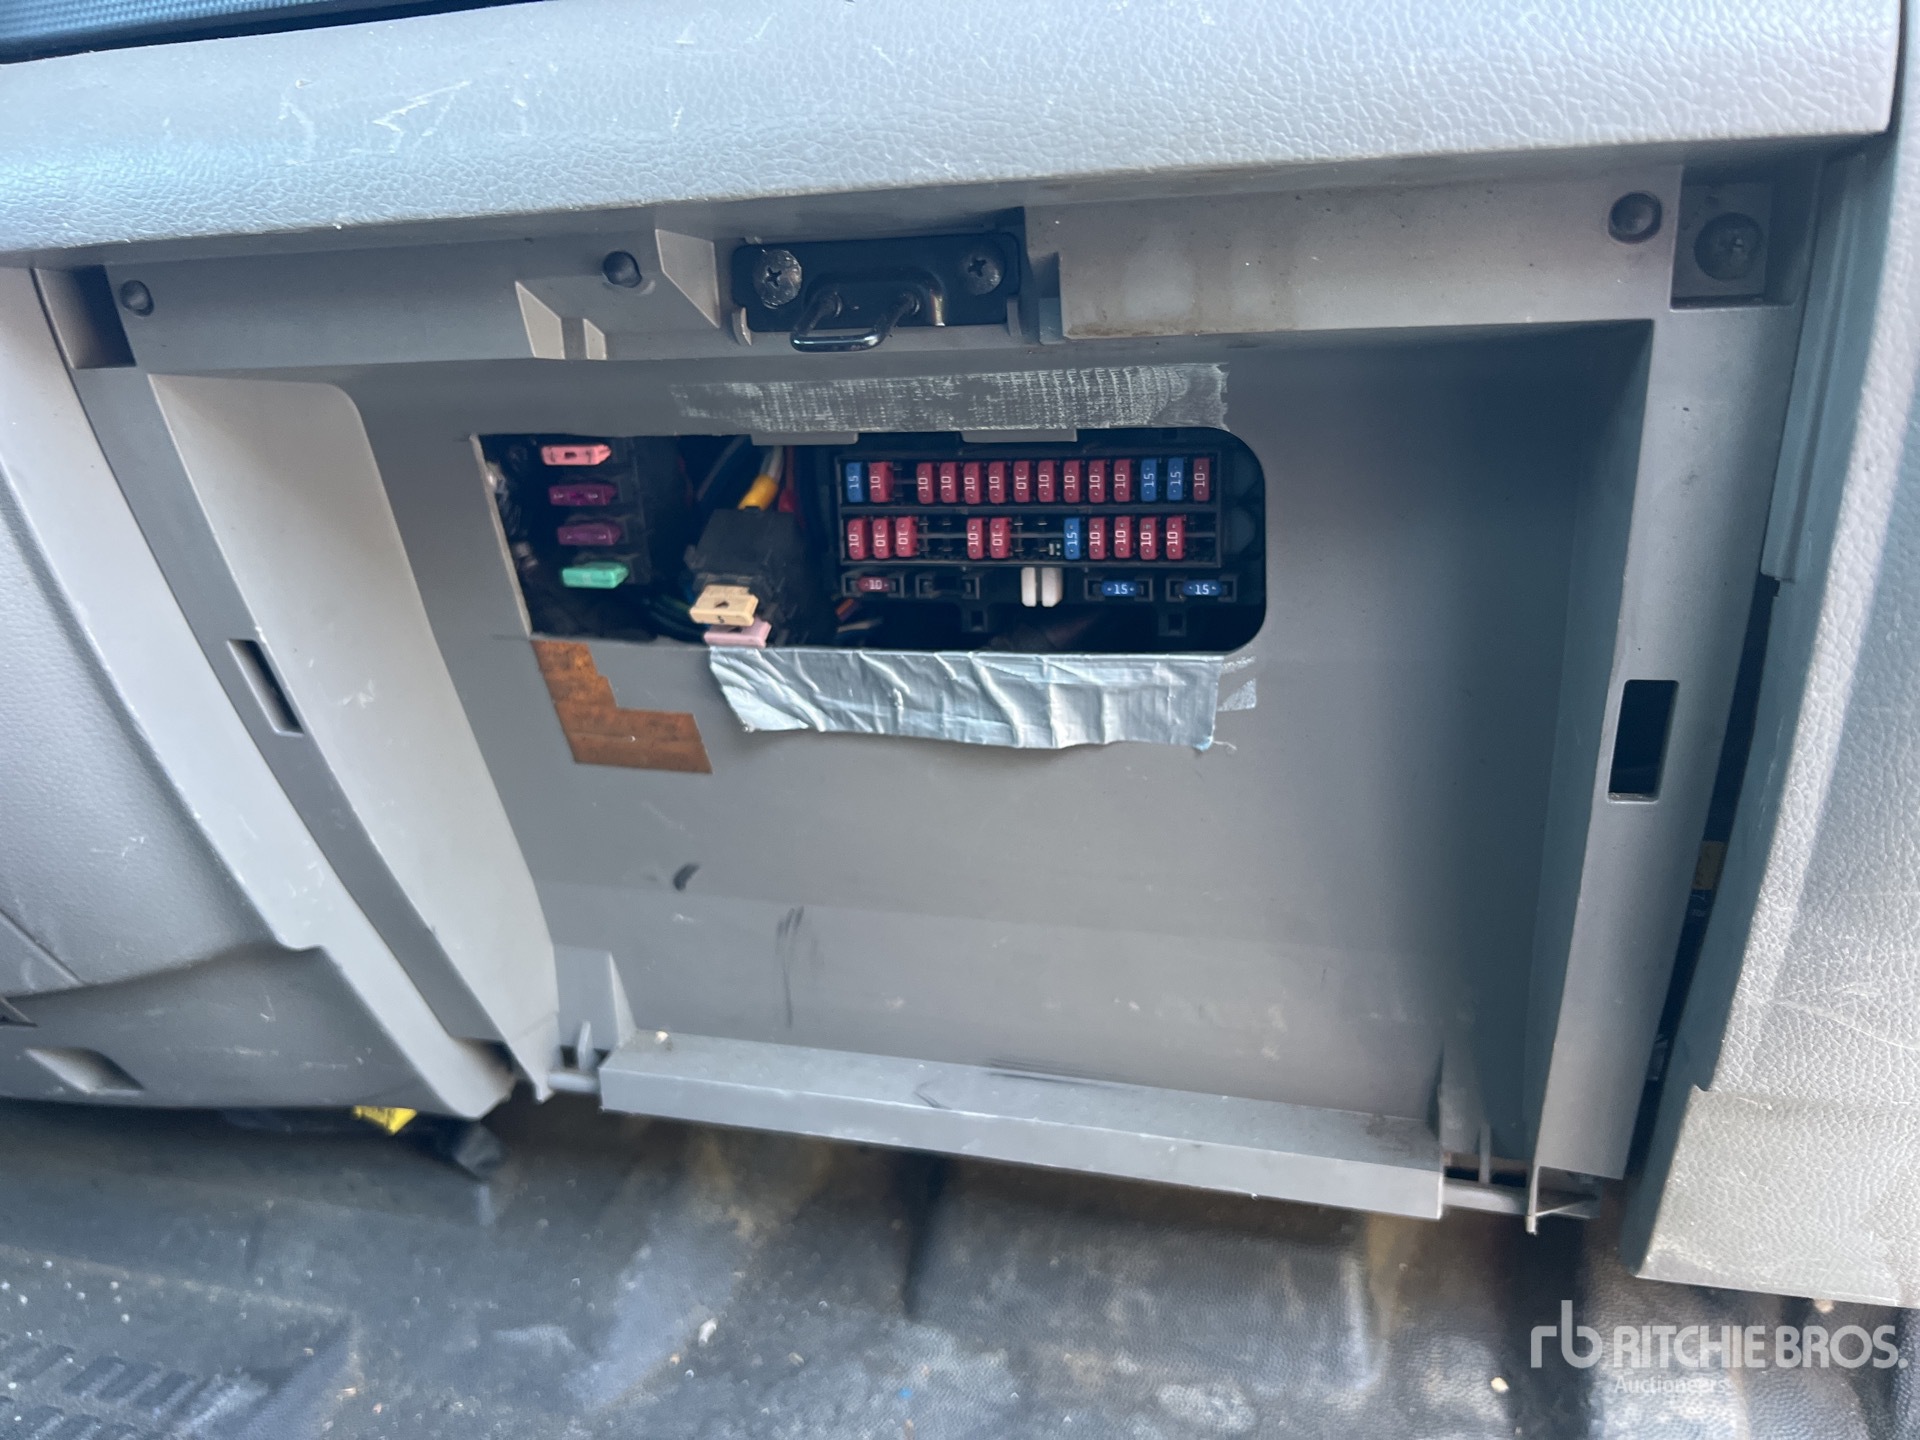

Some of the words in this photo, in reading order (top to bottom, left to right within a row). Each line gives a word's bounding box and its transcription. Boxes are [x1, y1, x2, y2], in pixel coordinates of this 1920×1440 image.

[850, 476, 859, 488] 15
[871, 476, 880, 489] 10
[918, 478, 928, 491] 10
[941, 476, 951, 489] 10
[965, 477, 975, 491] 10
[989, 477, 999, 490] 10
[1016, 476, 1027, 489] 10
[1039, 475, 1049, 488] 10
[1065, 476, 1075, 489] 10
[1089, 475, 1100, 489] 10
[1115, 474, 1125, 488] 10
[1144, 473, 1154, 488] 15
[1171, 472, 1181, 486] 15
[1195, 473, 1205, 487] 10
[849, 534, 859, 547] 10
[876, 534, 885, 547] 10
[898, 532, 908, 544] 10
[968, 533, 978, 546] 10
[992, 532, 1002, 546] 10
[1067, 533, 1077, 546] 15
[1090, 533, 1100, 546] 10
[1115, 530, 1126, 544] 10
[1141, 533, 1151, 546] 10
[1167, 532, 1178, 546] 10
[1115, 584, 1127, 594] 15
[1196, 584, 1209, 595] 15
